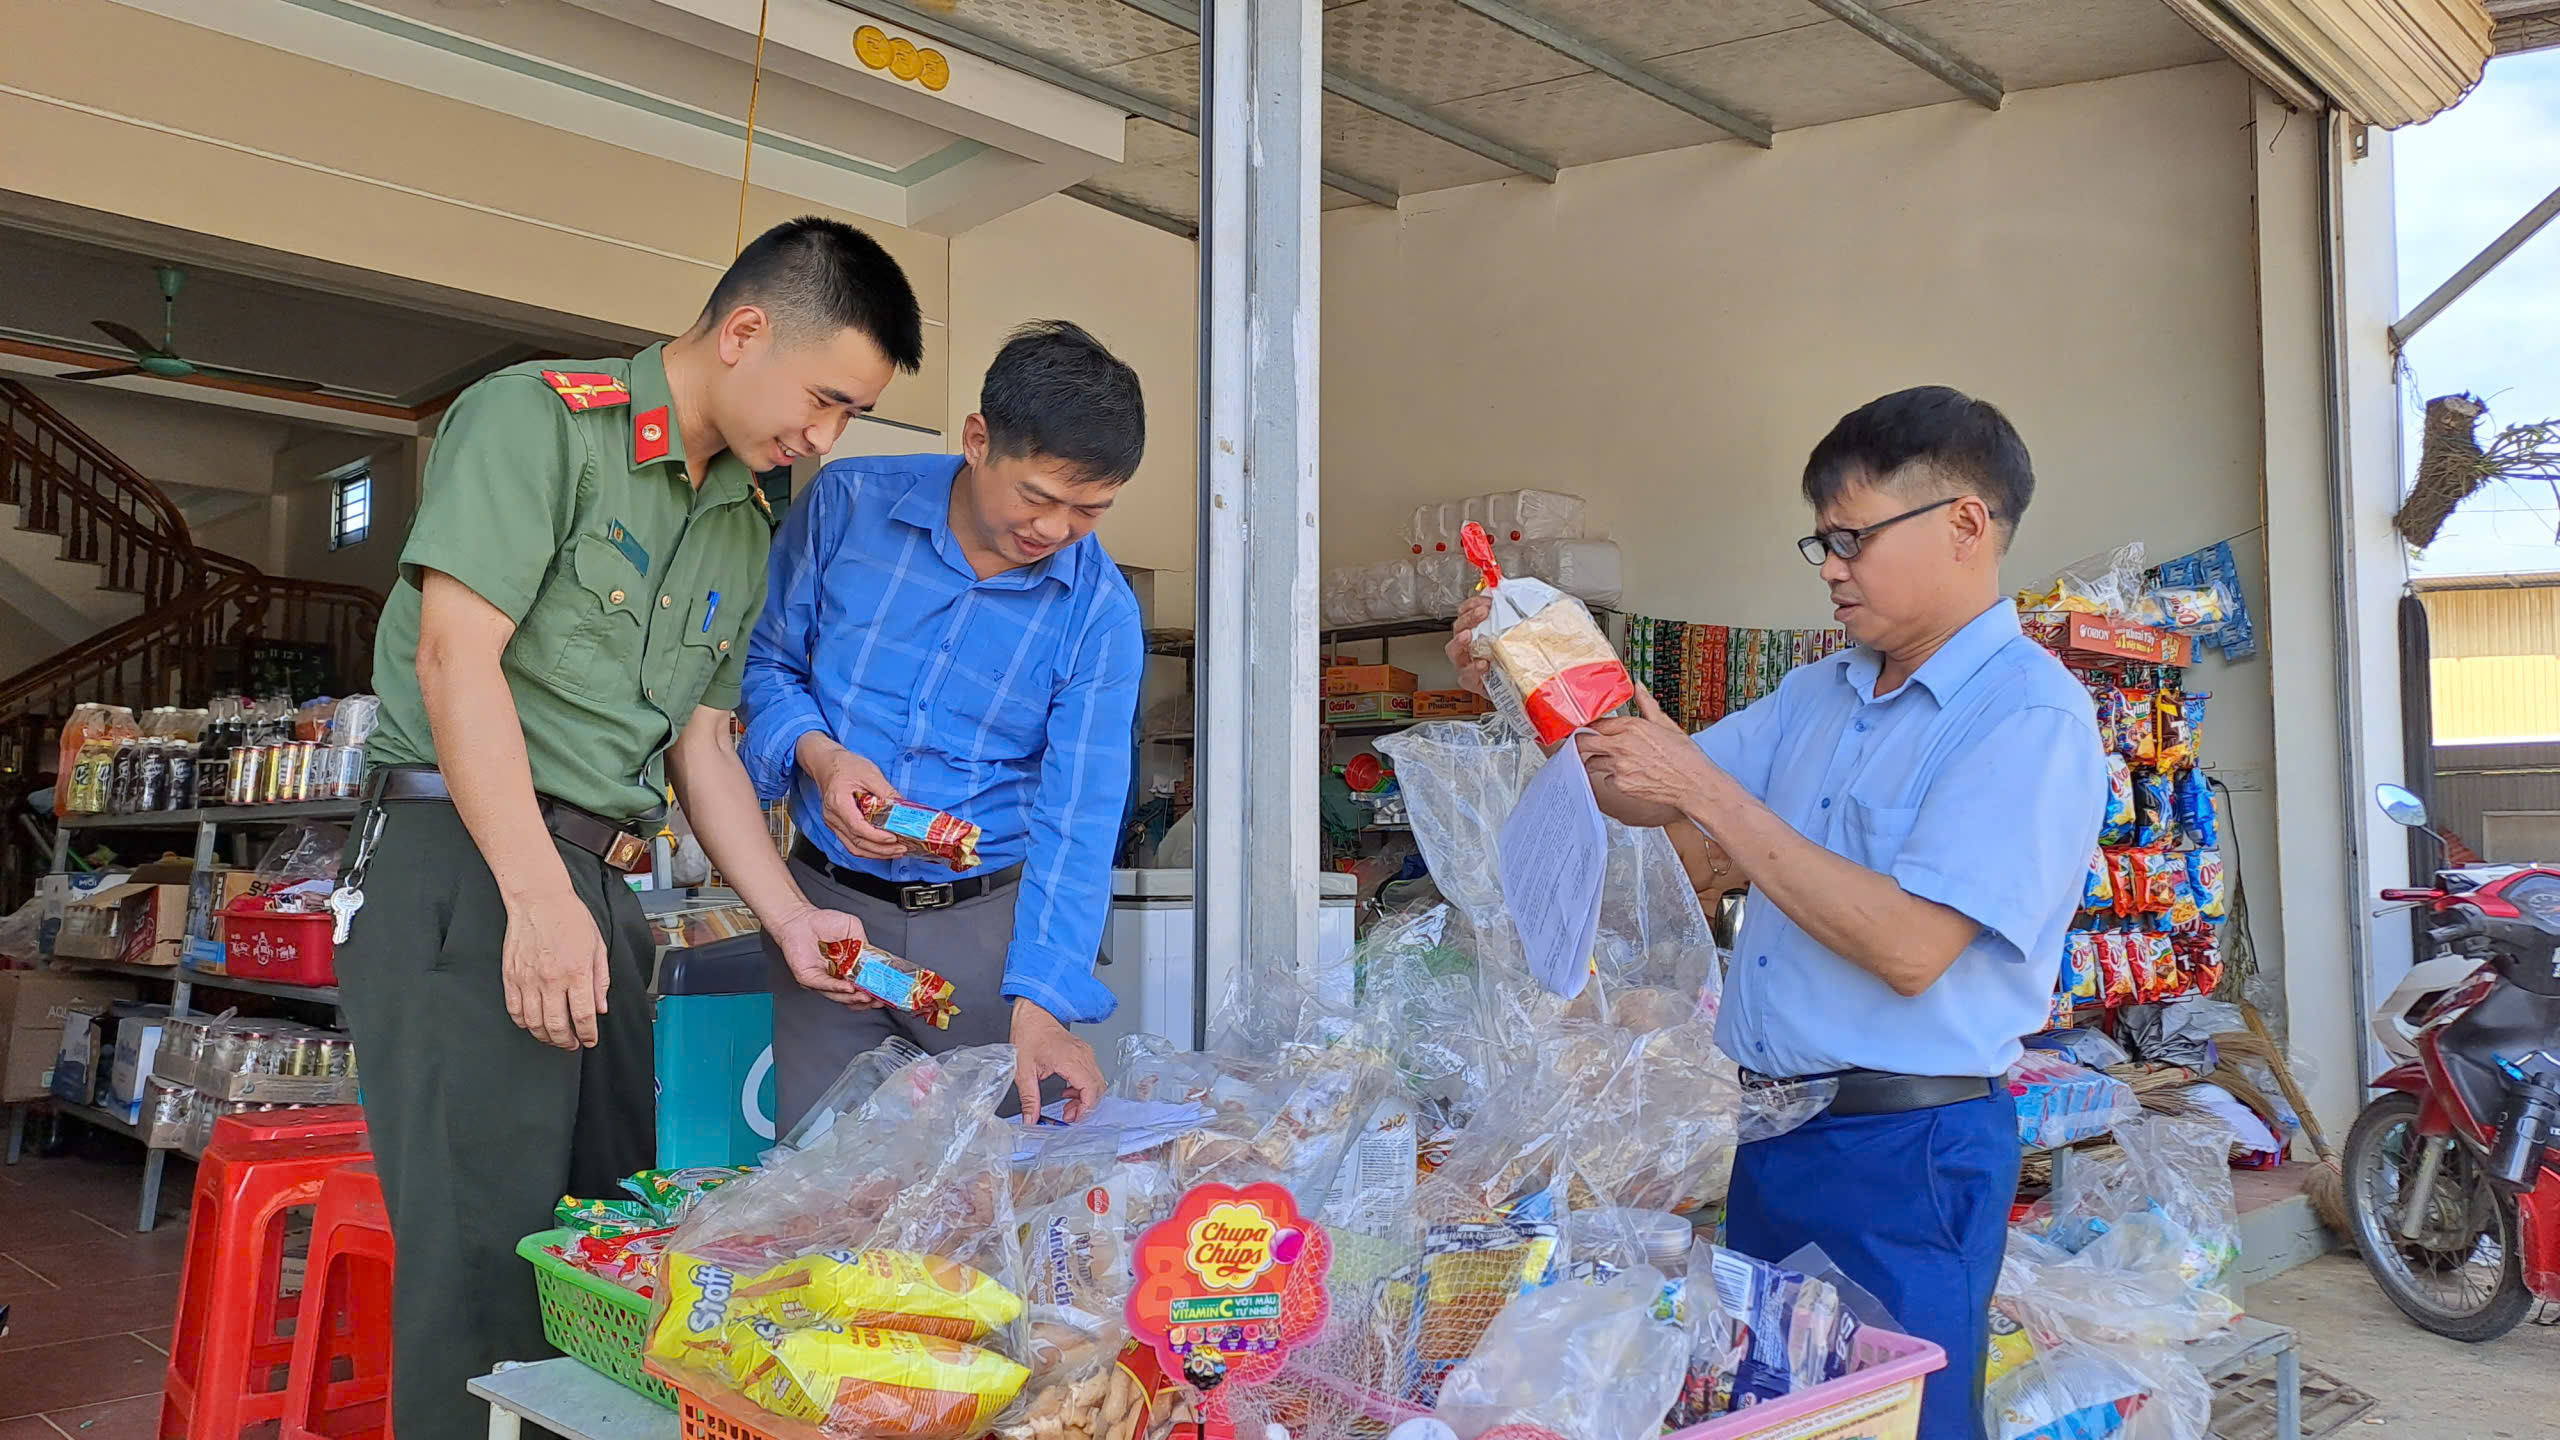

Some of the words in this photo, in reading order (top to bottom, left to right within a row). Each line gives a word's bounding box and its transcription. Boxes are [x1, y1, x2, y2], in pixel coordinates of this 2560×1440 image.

[1201, 1222, 1269, 1247] Chupa
[1048, 1215, 1075, 1307] Sandwich
[1195, 1242, 1263, 1278] Chups
[688, 1263, 735, 1334] Staff
[1172, 1306, 1219, 1320] VITAMIN
[1219, 1298, 1233, 1318] C
[1235, 1296, 1253, 1306] VỚI
